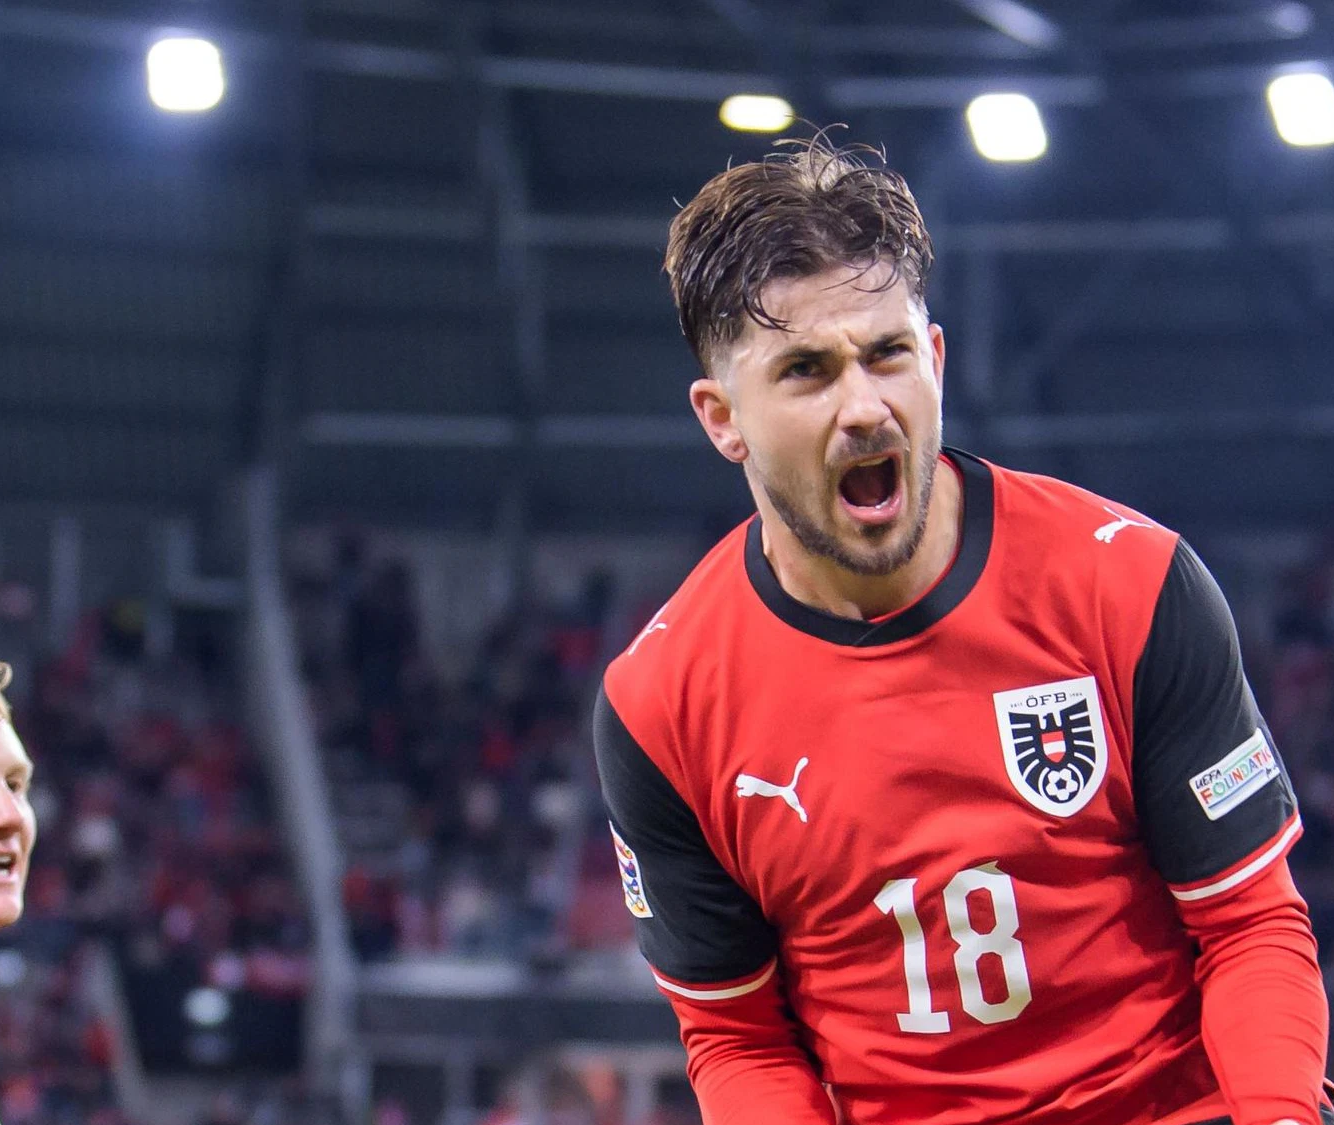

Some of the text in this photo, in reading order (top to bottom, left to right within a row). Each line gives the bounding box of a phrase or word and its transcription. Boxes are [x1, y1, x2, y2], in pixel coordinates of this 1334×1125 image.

[1026, 692, 1067, 708] ÖFB
[1195, 769, 1222, 790] UEFA
[873, 860, 1033, 1034] 18
